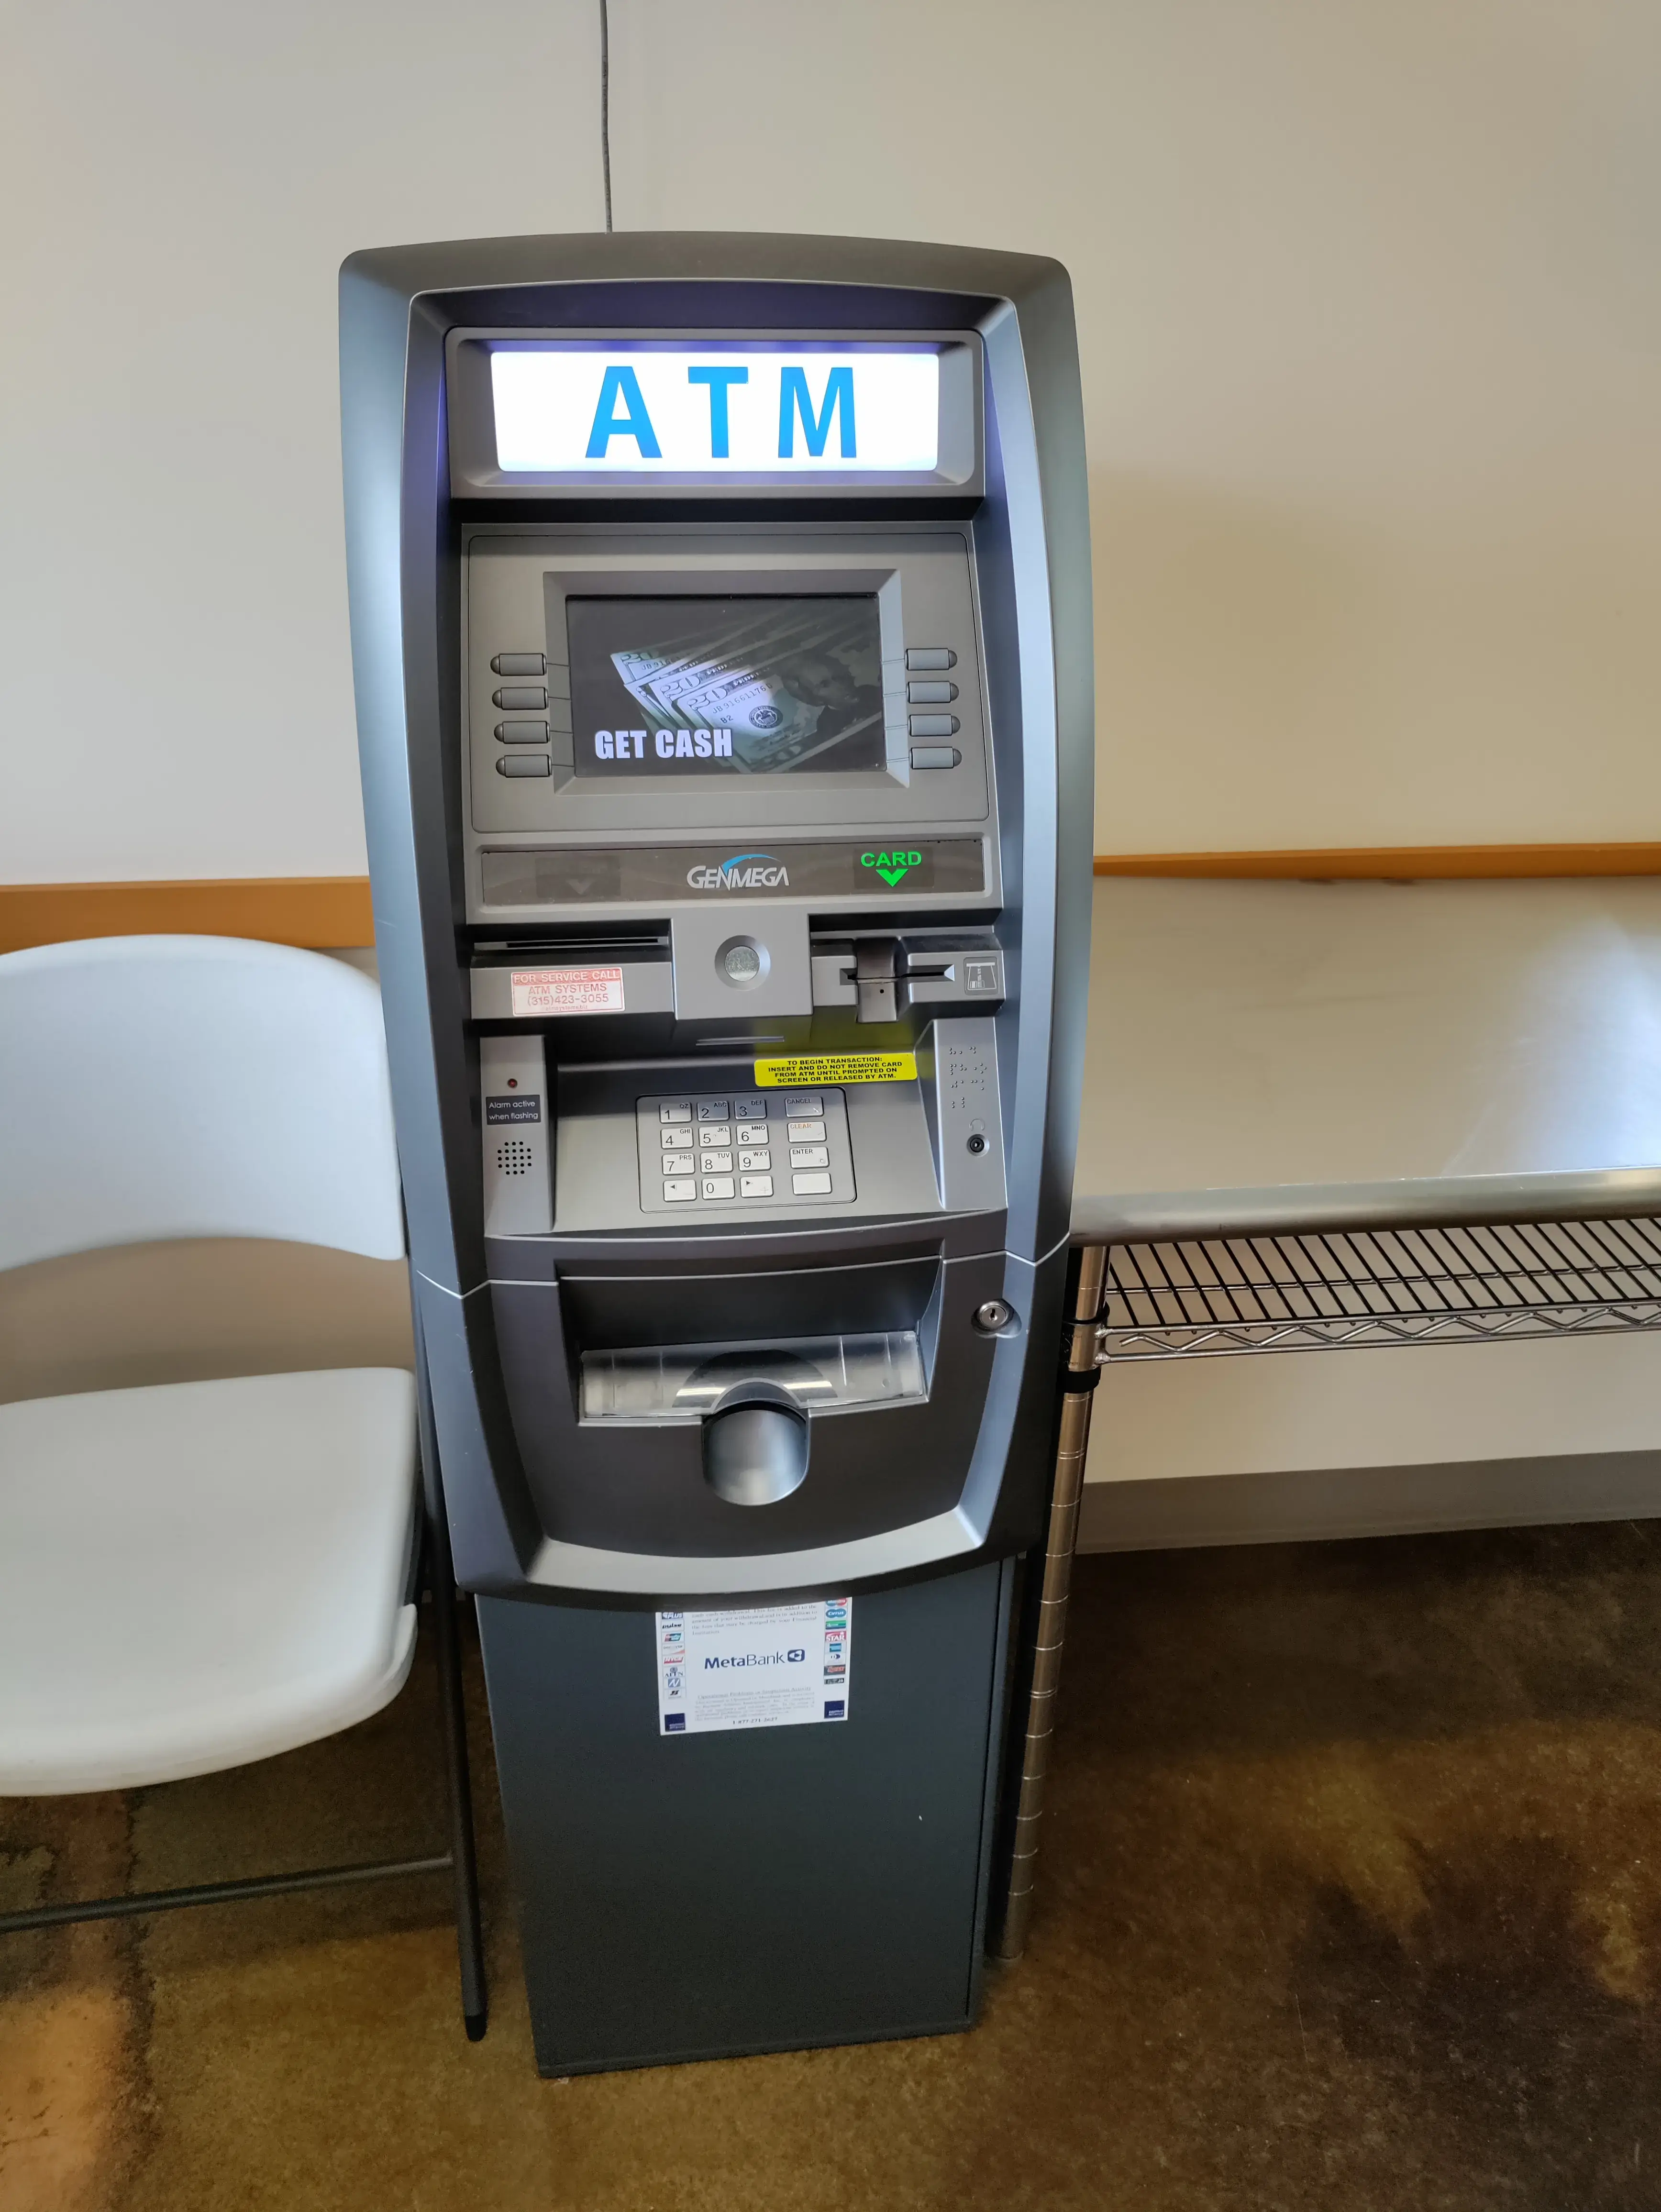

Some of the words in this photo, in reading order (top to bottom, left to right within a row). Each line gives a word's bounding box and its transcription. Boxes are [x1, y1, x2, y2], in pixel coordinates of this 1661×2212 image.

[585, 366, 857, 458] ATM
[687, 687, 728, 711] 20
[712, 706, 723, 714] JB
[720, 715, 734, 724] B2
[595, 730, 647, 759] GET
[655, 729, 732, 758] CASH
[861, 852, 922, 867] CARD
[687, 865, 789, 890] GENMEGA
[514, 974, 536, 984] FOR
[542, 972, 588, 982] SERVICE
[592, 970, 620, 980] CALL
[529, 986, 550, 995] ATM
[555, 983, 607, 994] SYSTEMS
[528, 994, 609, 1006] (315)423-3055
[664, 1109, 670, 1120] 1
[701, 1108, 709, 1118] 2
[740, 1106, 747, 1116] 3
[665, 1135, 674, 1146] 4
[703, 1133, 711, 1144] 5
[741, 1131, 749, 1142] 6
[667, 1161, 675, 1172] 7
[705, 1160, 713, 1170] 8
[743, 1157, 751, 1168] 9
[706, 1183, 714, 1194] 0
[705, 1650, 785, 1670] MetaBank
